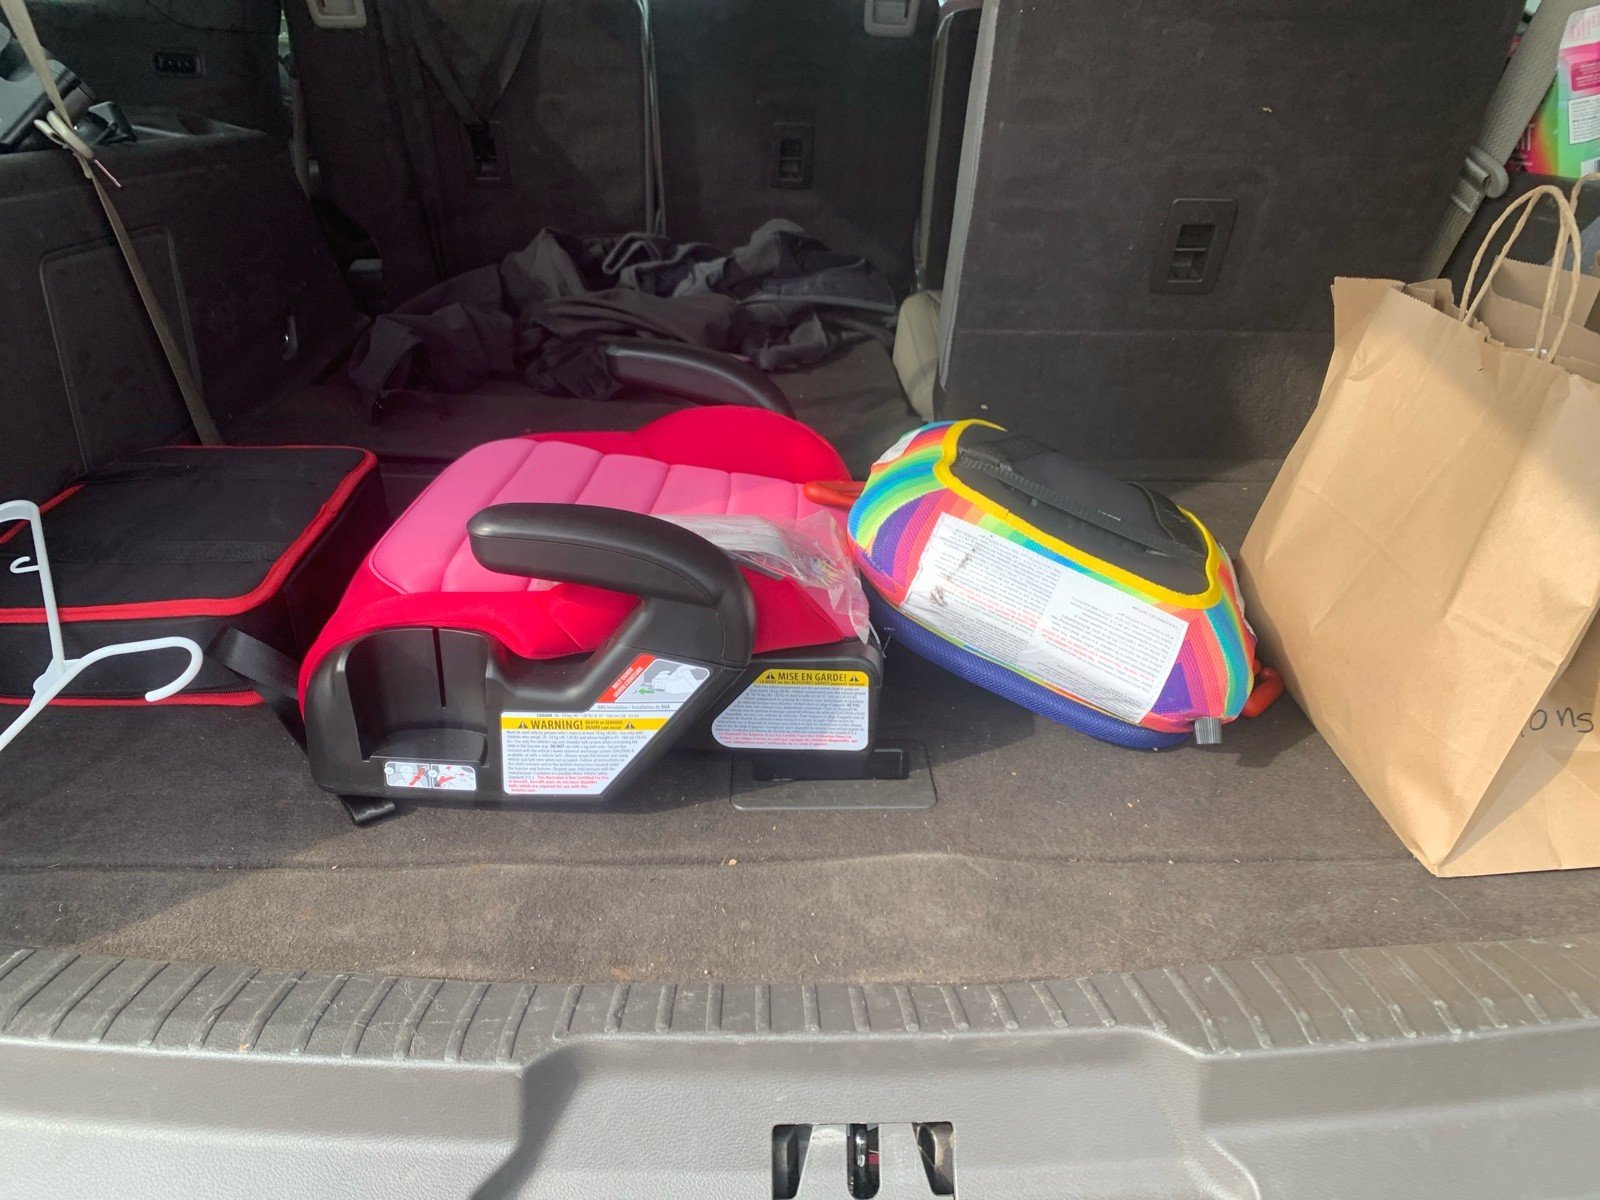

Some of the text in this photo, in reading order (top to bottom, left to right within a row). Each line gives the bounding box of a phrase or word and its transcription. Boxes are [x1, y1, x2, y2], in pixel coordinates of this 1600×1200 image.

[777, 672, 847, 682] MISE EN GARDE!
[530, 720, 583, 730] WARNING!
